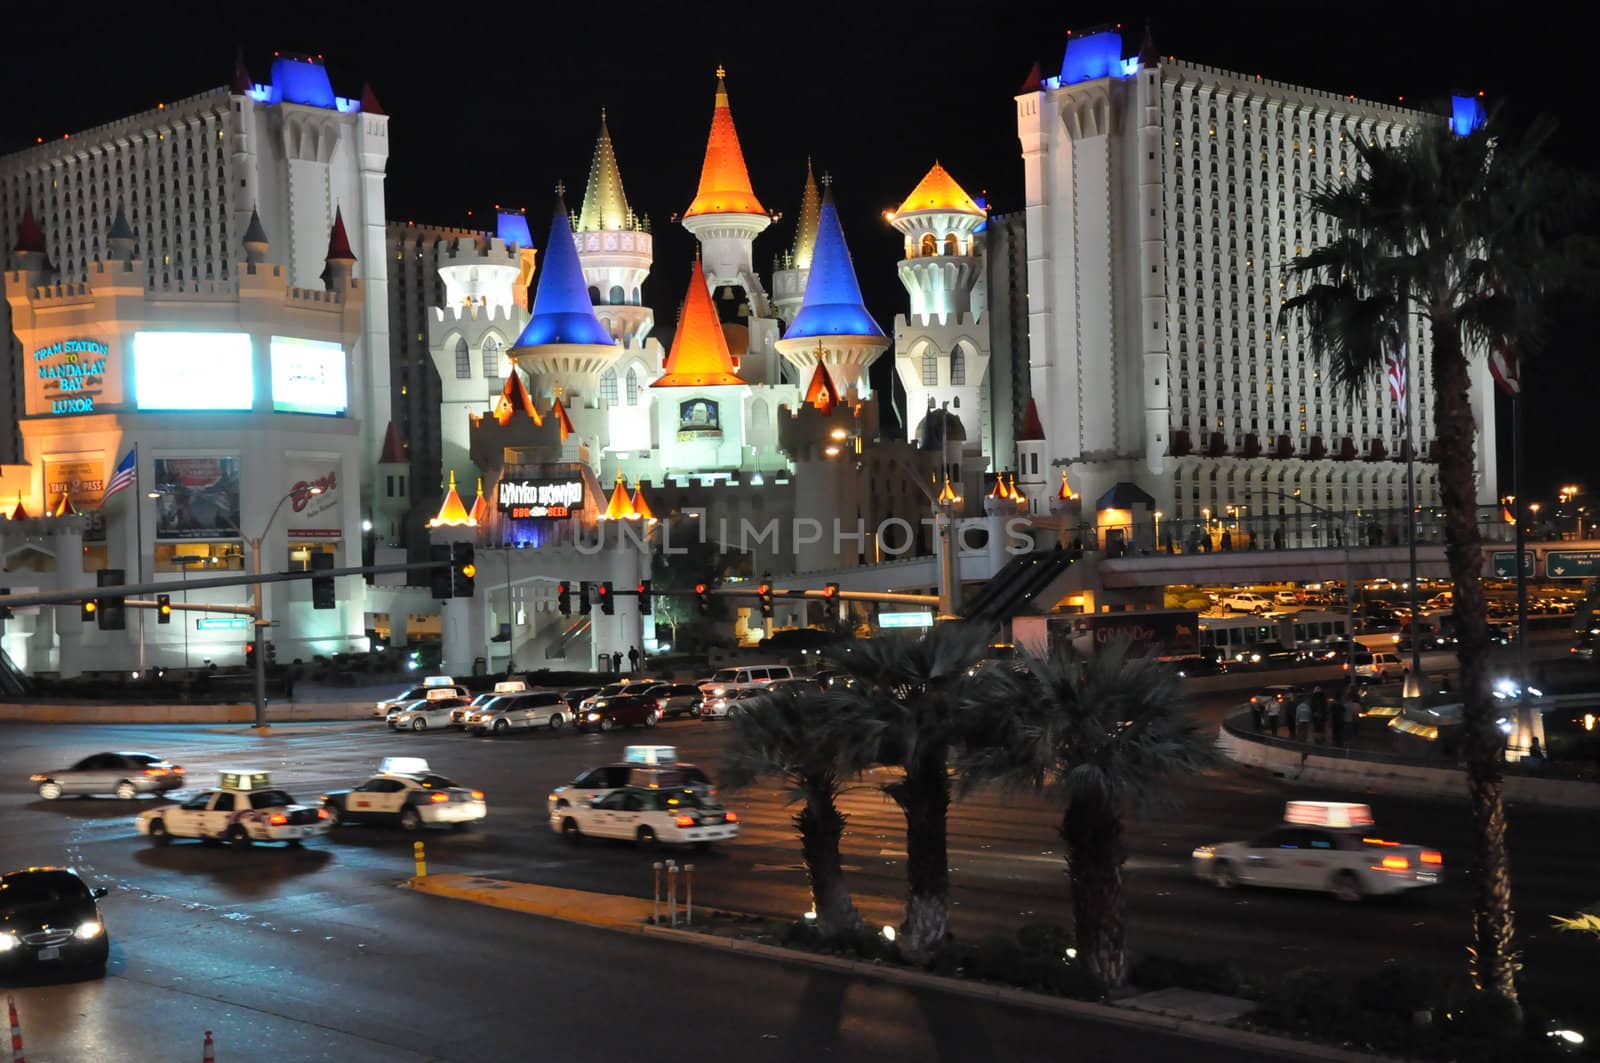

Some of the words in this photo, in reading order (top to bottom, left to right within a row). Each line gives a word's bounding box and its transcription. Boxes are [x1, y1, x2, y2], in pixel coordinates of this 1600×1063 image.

[34, 342, 63, 361] TRAM
[64, 339, 109, 356] STATION
[65, 353, 79, 363] TO
[39, 359, 106, 379] MANDALAY
[60, 376, 84, 391] BAY
[52, 397, 94, 415] LUXOR
[83, 480, 102, 491] PASS
[500, 481, 537, 507] LYNYRD
[512, 507, 530, 518] BBQ
[547, 506, 568, 517] BEER
